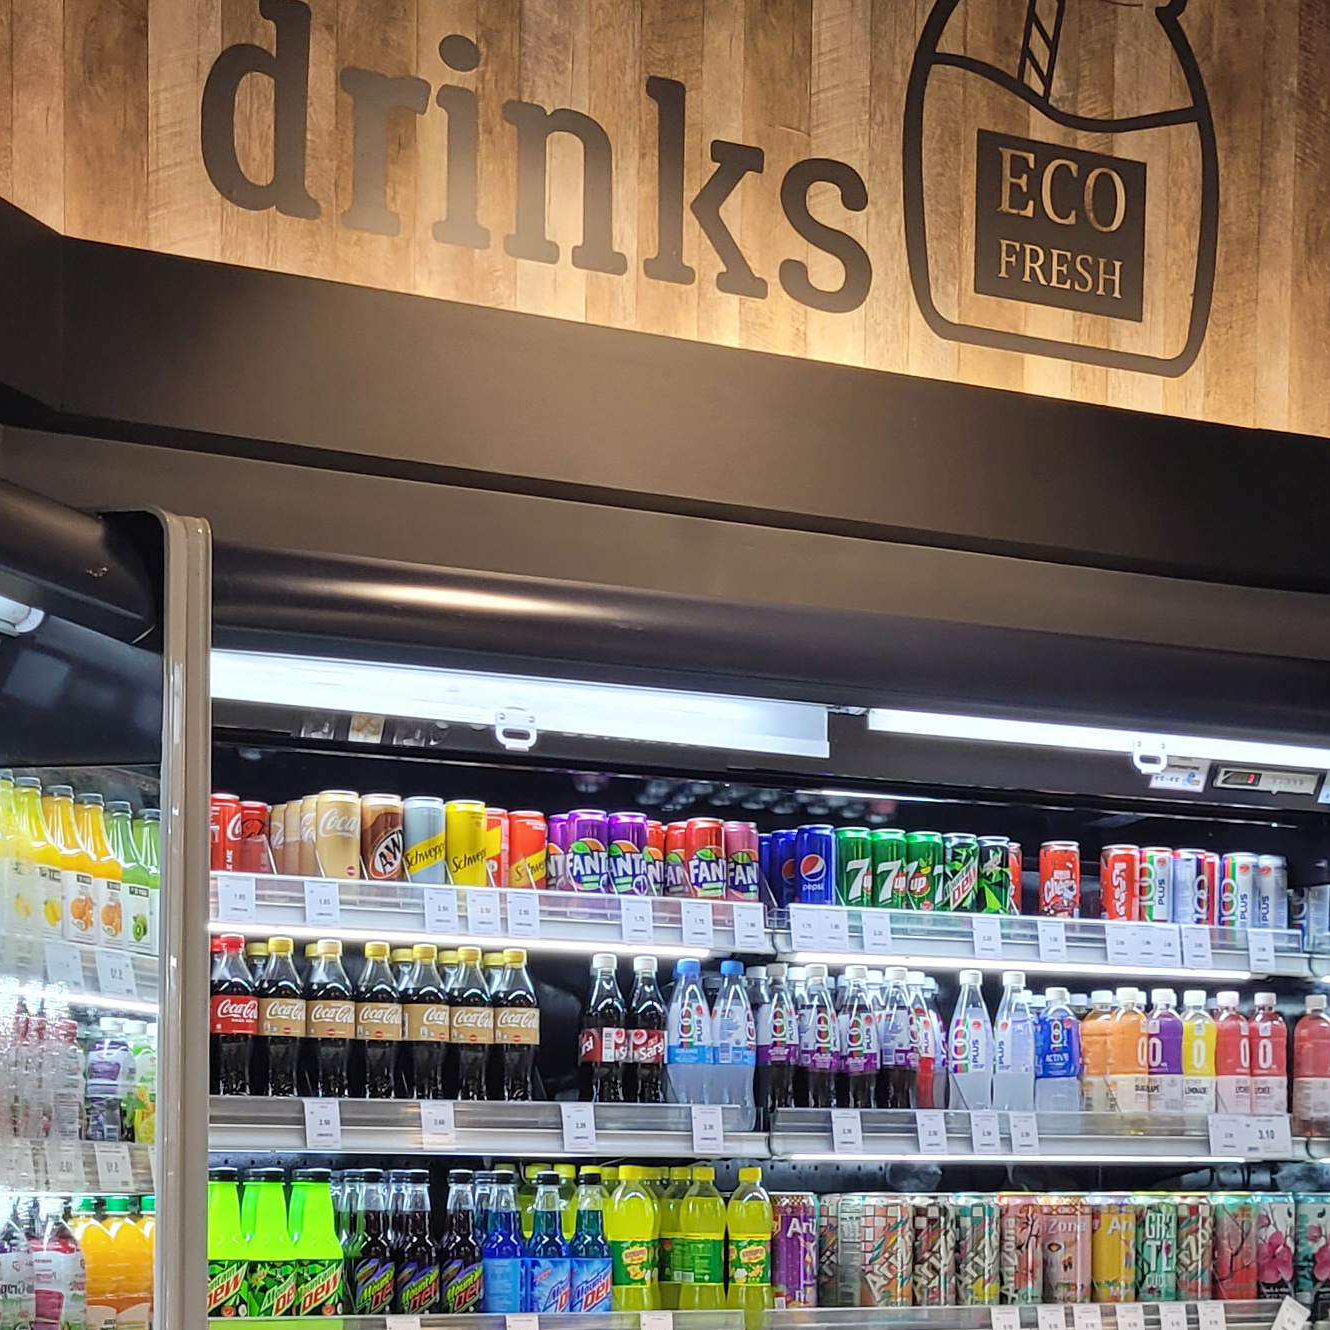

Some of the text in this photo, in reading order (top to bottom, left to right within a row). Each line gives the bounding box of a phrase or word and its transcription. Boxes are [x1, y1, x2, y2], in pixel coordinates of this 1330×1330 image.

[201, 0, 869, 313] drinks
[997, 146, 1127, 234] ECO
[997, 241, 1123, 300] FRESH
[802, 882, 824, 892] pepsi
[846, 858, 868, 904] 7
